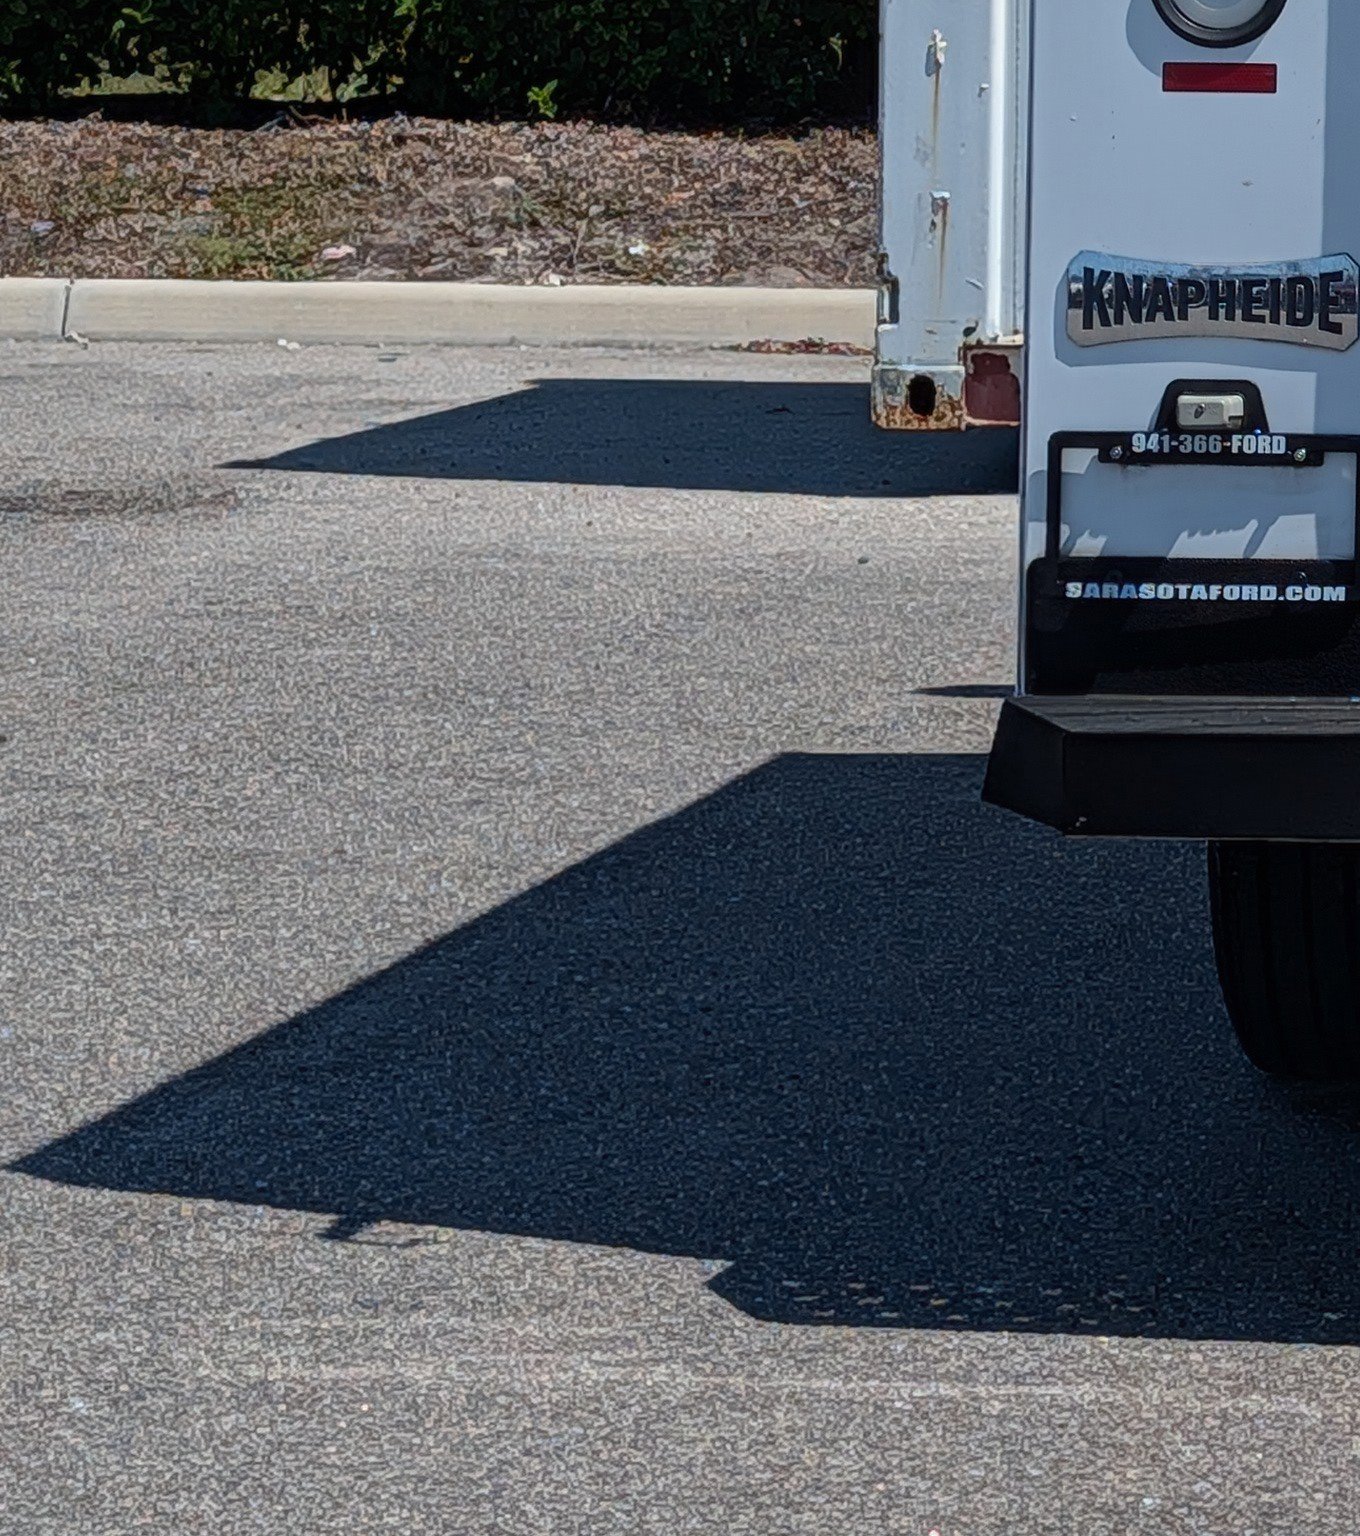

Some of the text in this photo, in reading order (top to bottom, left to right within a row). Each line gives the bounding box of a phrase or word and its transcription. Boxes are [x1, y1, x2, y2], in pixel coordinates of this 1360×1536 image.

[1081, 266, 1345, 336] KNAPHEIDE
[1131, 432, 1287, 456] 941-366-FORD
[1065, 581, 1347, 603] SARASOTAFORD.COM
